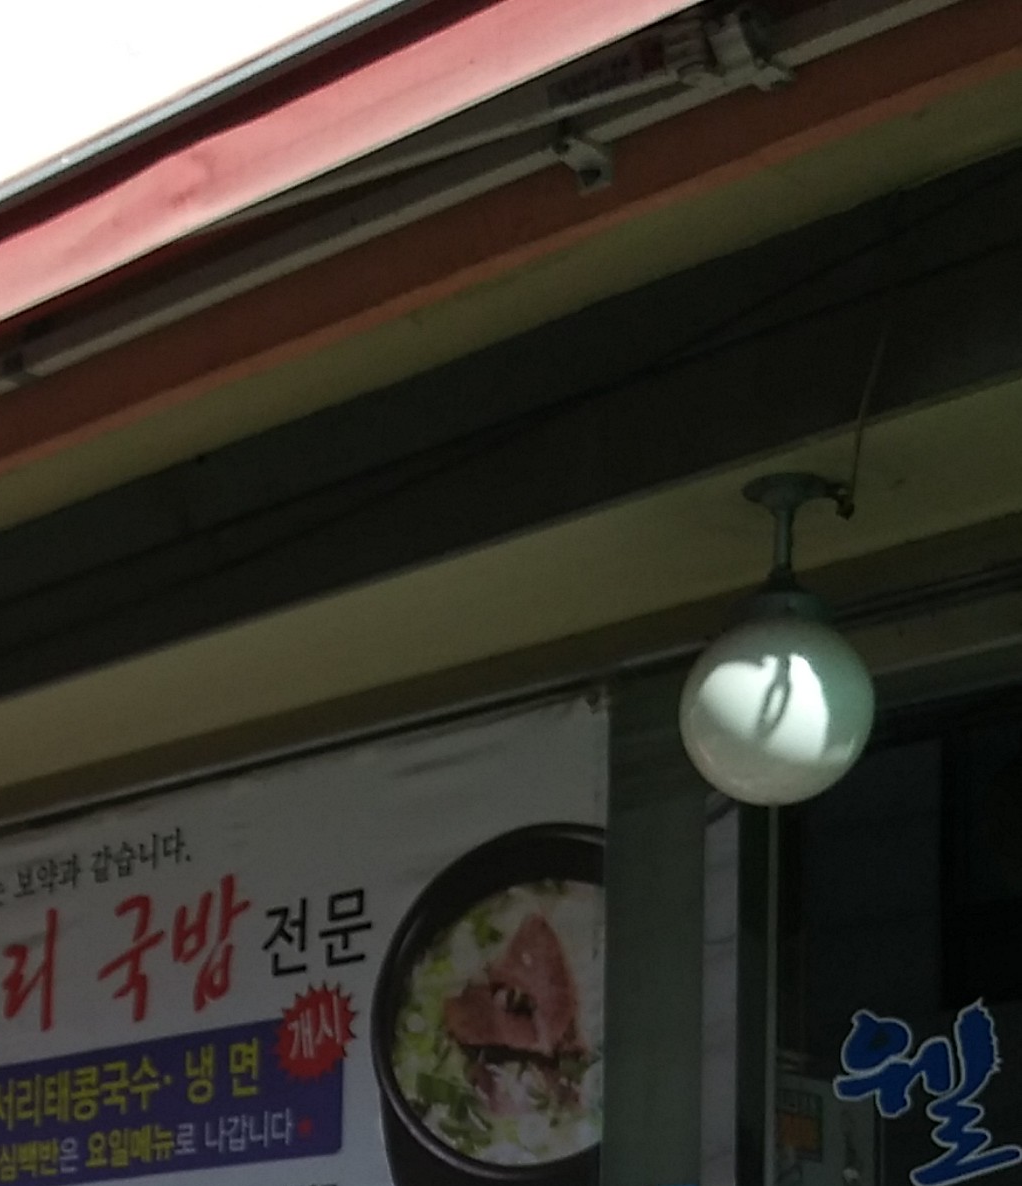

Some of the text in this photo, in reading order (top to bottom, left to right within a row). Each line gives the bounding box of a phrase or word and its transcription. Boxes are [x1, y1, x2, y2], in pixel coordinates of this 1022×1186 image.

[13, 853, 82, 897] 보약과
[90, 827, 192, 881] 같습니다.
[97, 873, 250, 1023] 국밥
[262, 889, 372, 976] 전문
[287, 993, 342, 1061] 개시
[86, 1122, 197, 1169] 요일메뉴로
[205, 1107, 294, 1154] 나갑니다
